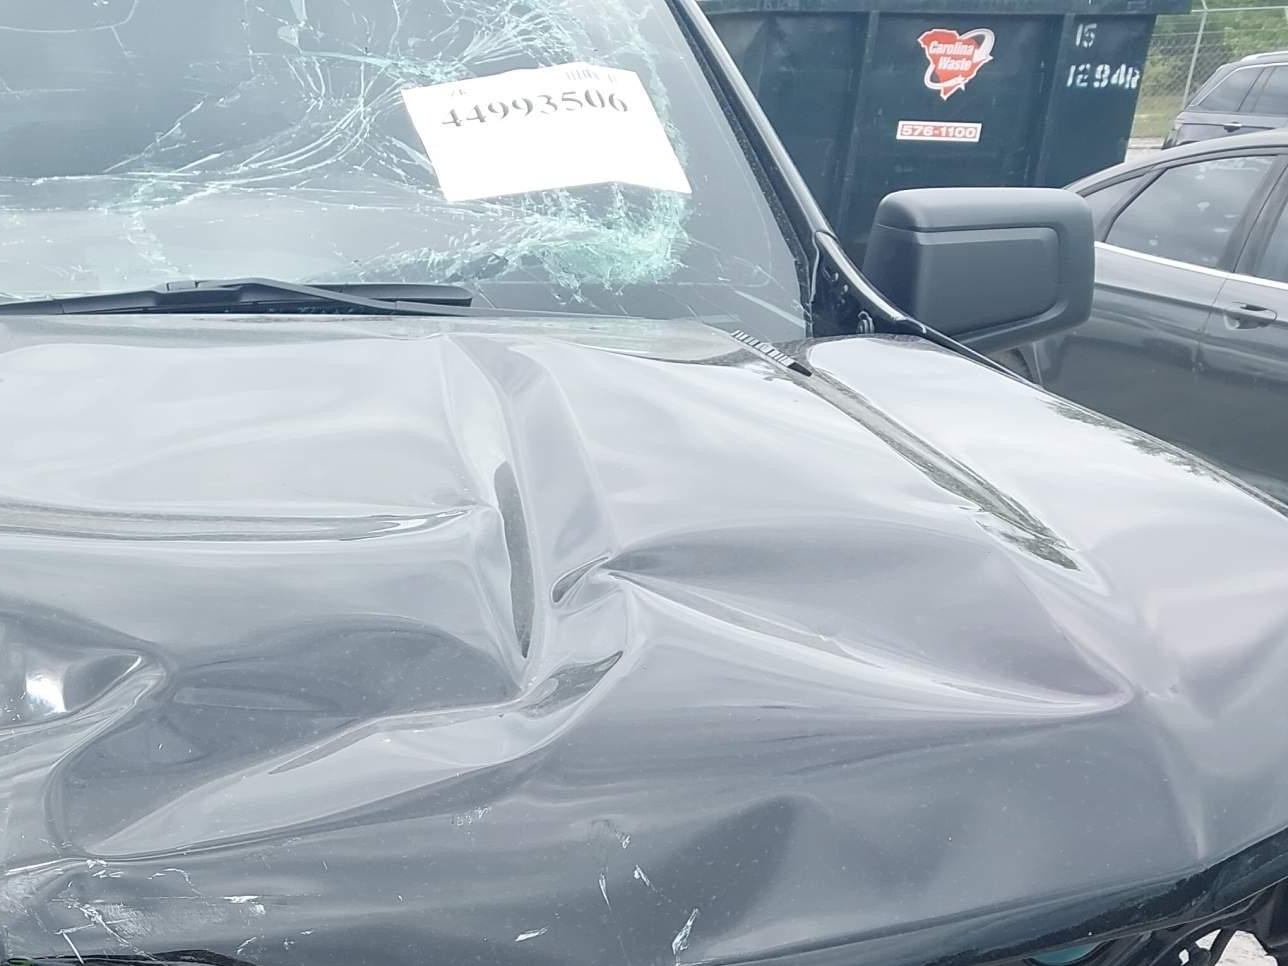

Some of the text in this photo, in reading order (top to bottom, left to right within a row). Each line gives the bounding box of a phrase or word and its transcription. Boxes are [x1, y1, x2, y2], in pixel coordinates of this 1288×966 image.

[1076, 23, 1097, 48] 15
[929, 41, 974, 56] Carolina
[938, 56, 972, 71] Waste
[442, 89, 628, 127] 44993506
[902, 123, 977, 138] 576-1100
